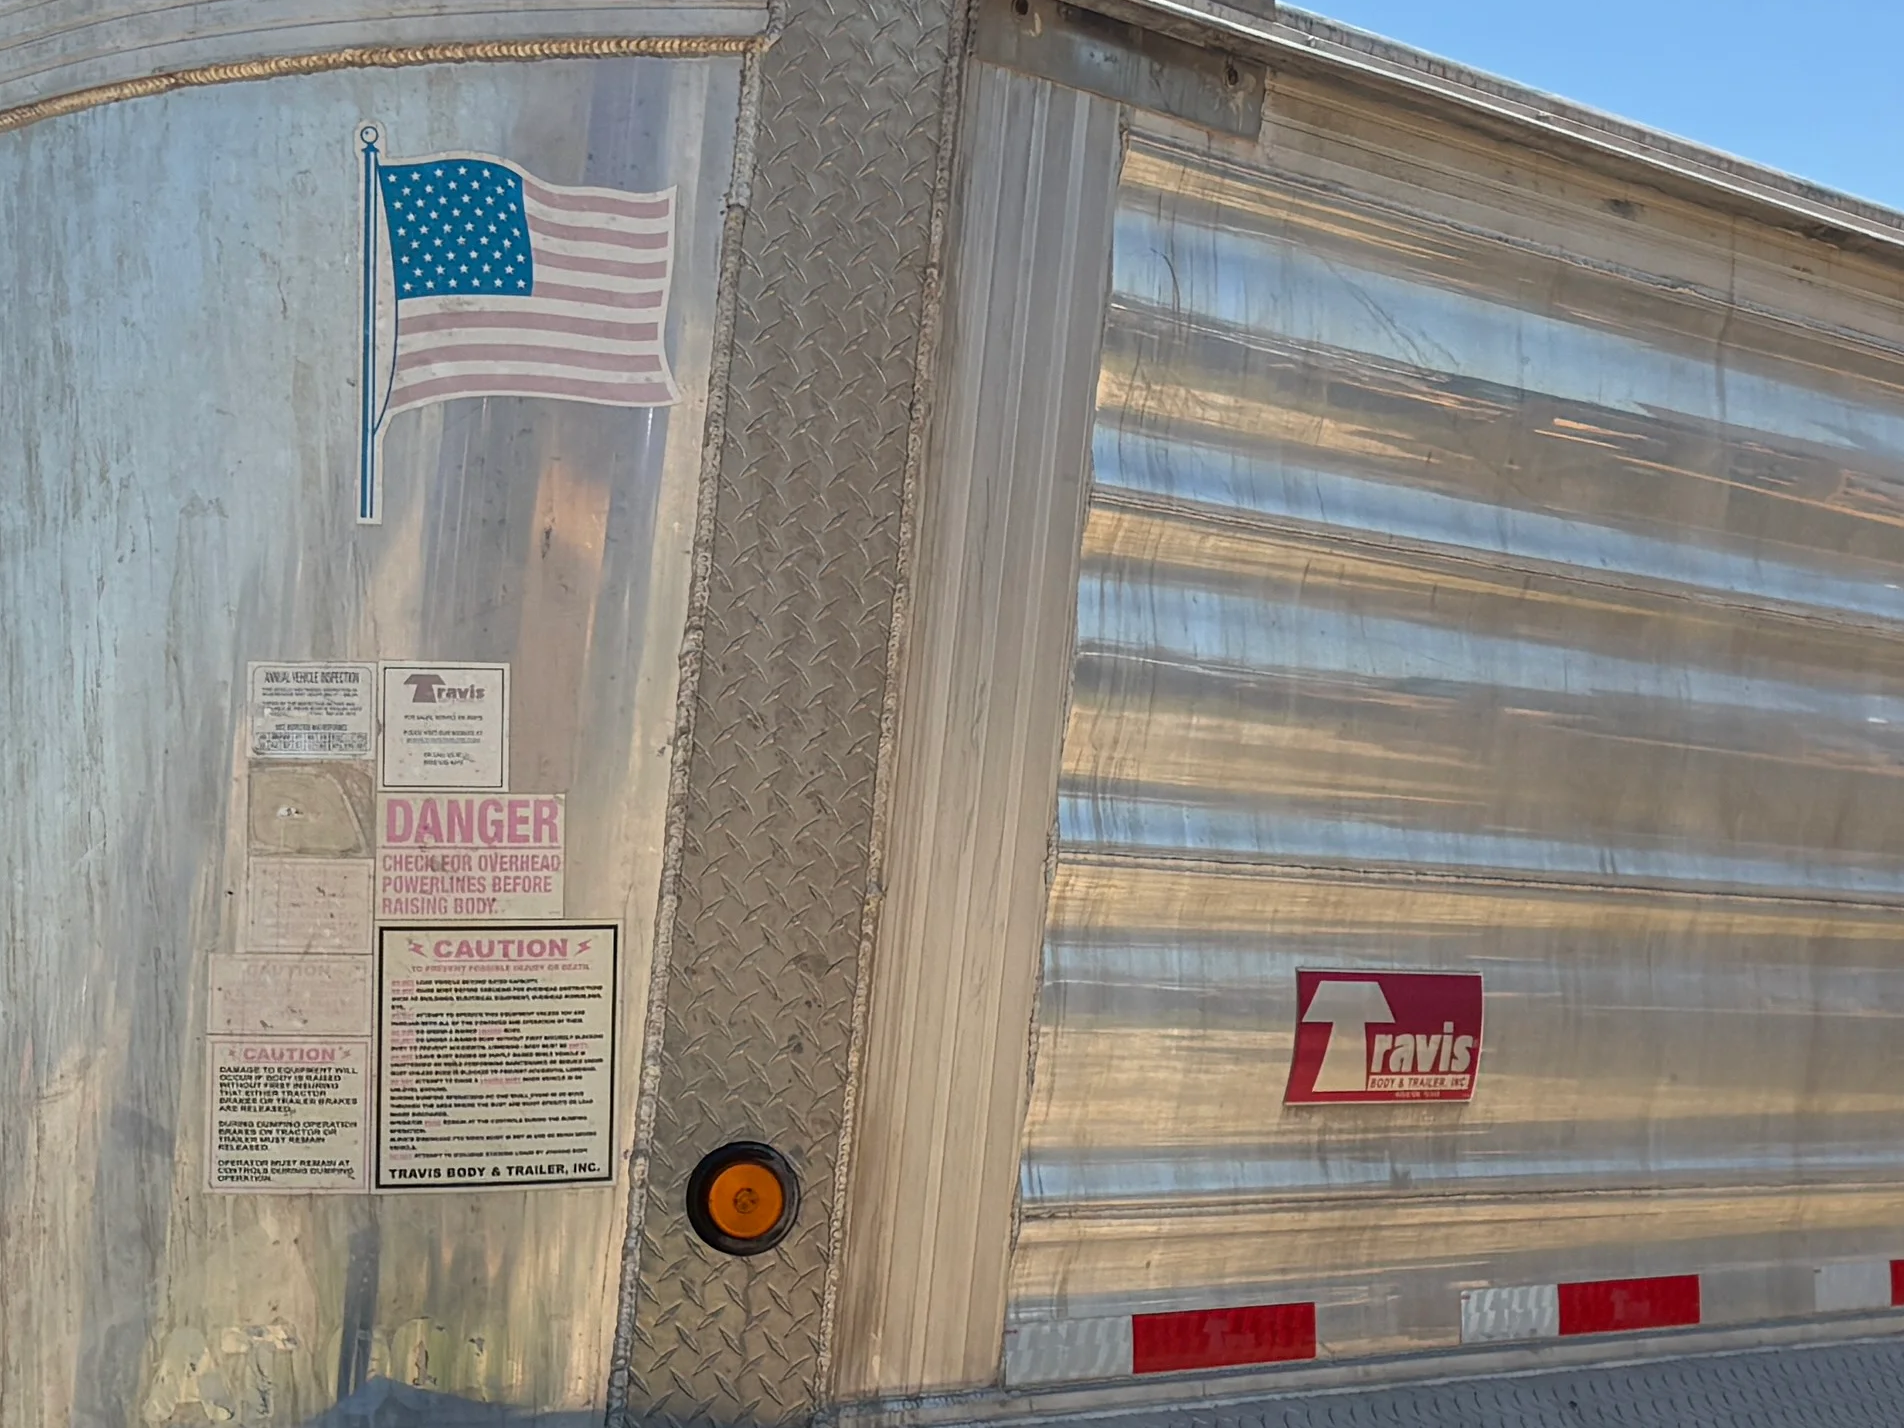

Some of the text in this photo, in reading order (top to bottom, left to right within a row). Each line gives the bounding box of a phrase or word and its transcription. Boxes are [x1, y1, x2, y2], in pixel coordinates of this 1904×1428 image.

[292, 672, 318, 683] VEHICLE
[321, 672, 360, 683] INSPECTION
[403, 674, 485, 703] Travis
[386, 798, 558, 844] DANGER
[382, 854, 561, 872] CHECK FOR OVERHEAD
[382, 875, 553, 894] POWERLINES BEFORE
[382, 897, 448, 914] RAISING
[433, 939, 568, 958] CAUTION
[1302, 980, 1474, 1092] Travis
[243, 1048, 336, 1061] CAUTION
[1370, 1077, 1396, 1088] BODY
[1398, 1078, 1404, 1088] &
[388, 1162, 600, 1179] TRAVIS BODY & TRAILER, INC.
